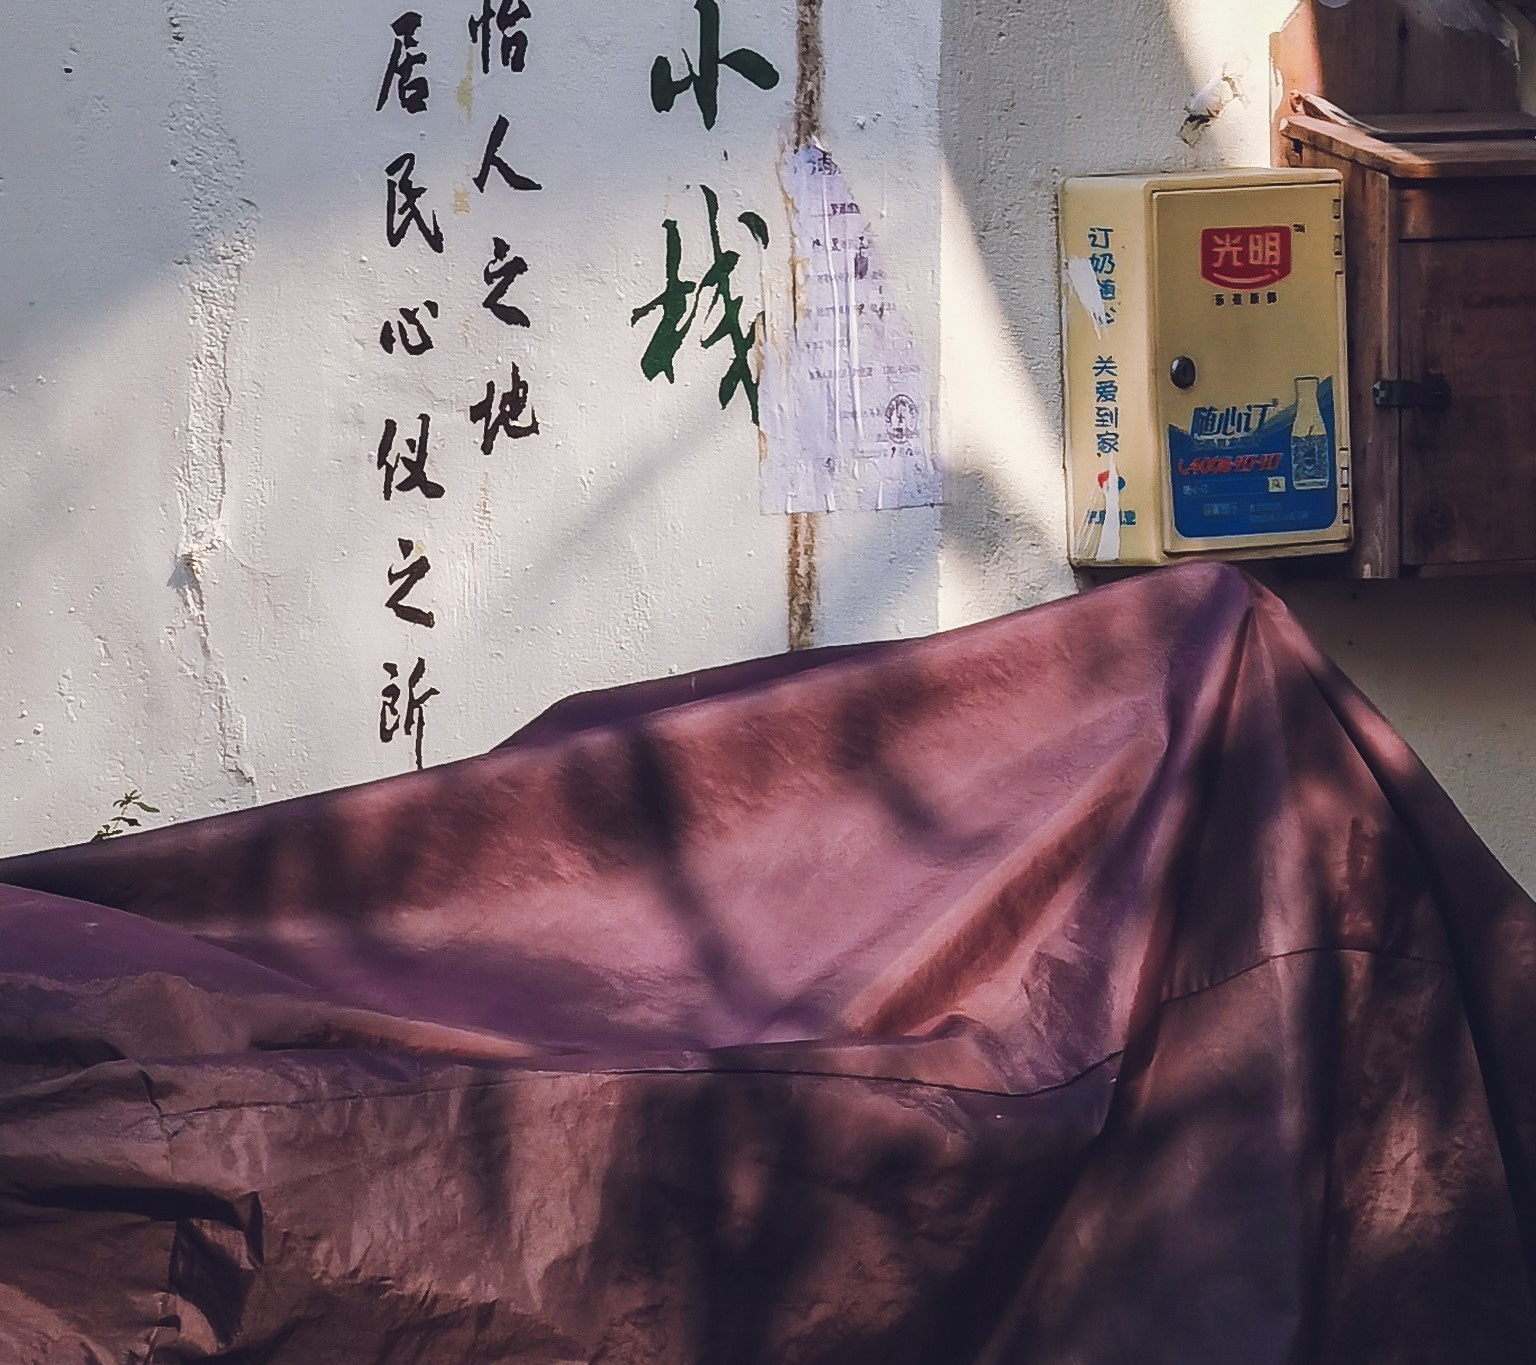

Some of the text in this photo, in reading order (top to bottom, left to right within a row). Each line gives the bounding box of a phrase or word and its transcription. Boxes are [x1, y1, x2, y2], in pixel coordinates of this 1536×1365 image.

[1212, 233, 1281, 267] 光明
[375, 12, 445, 769] 居民心仪之所
[1092, 355, 1119, 457] 关爱到家
